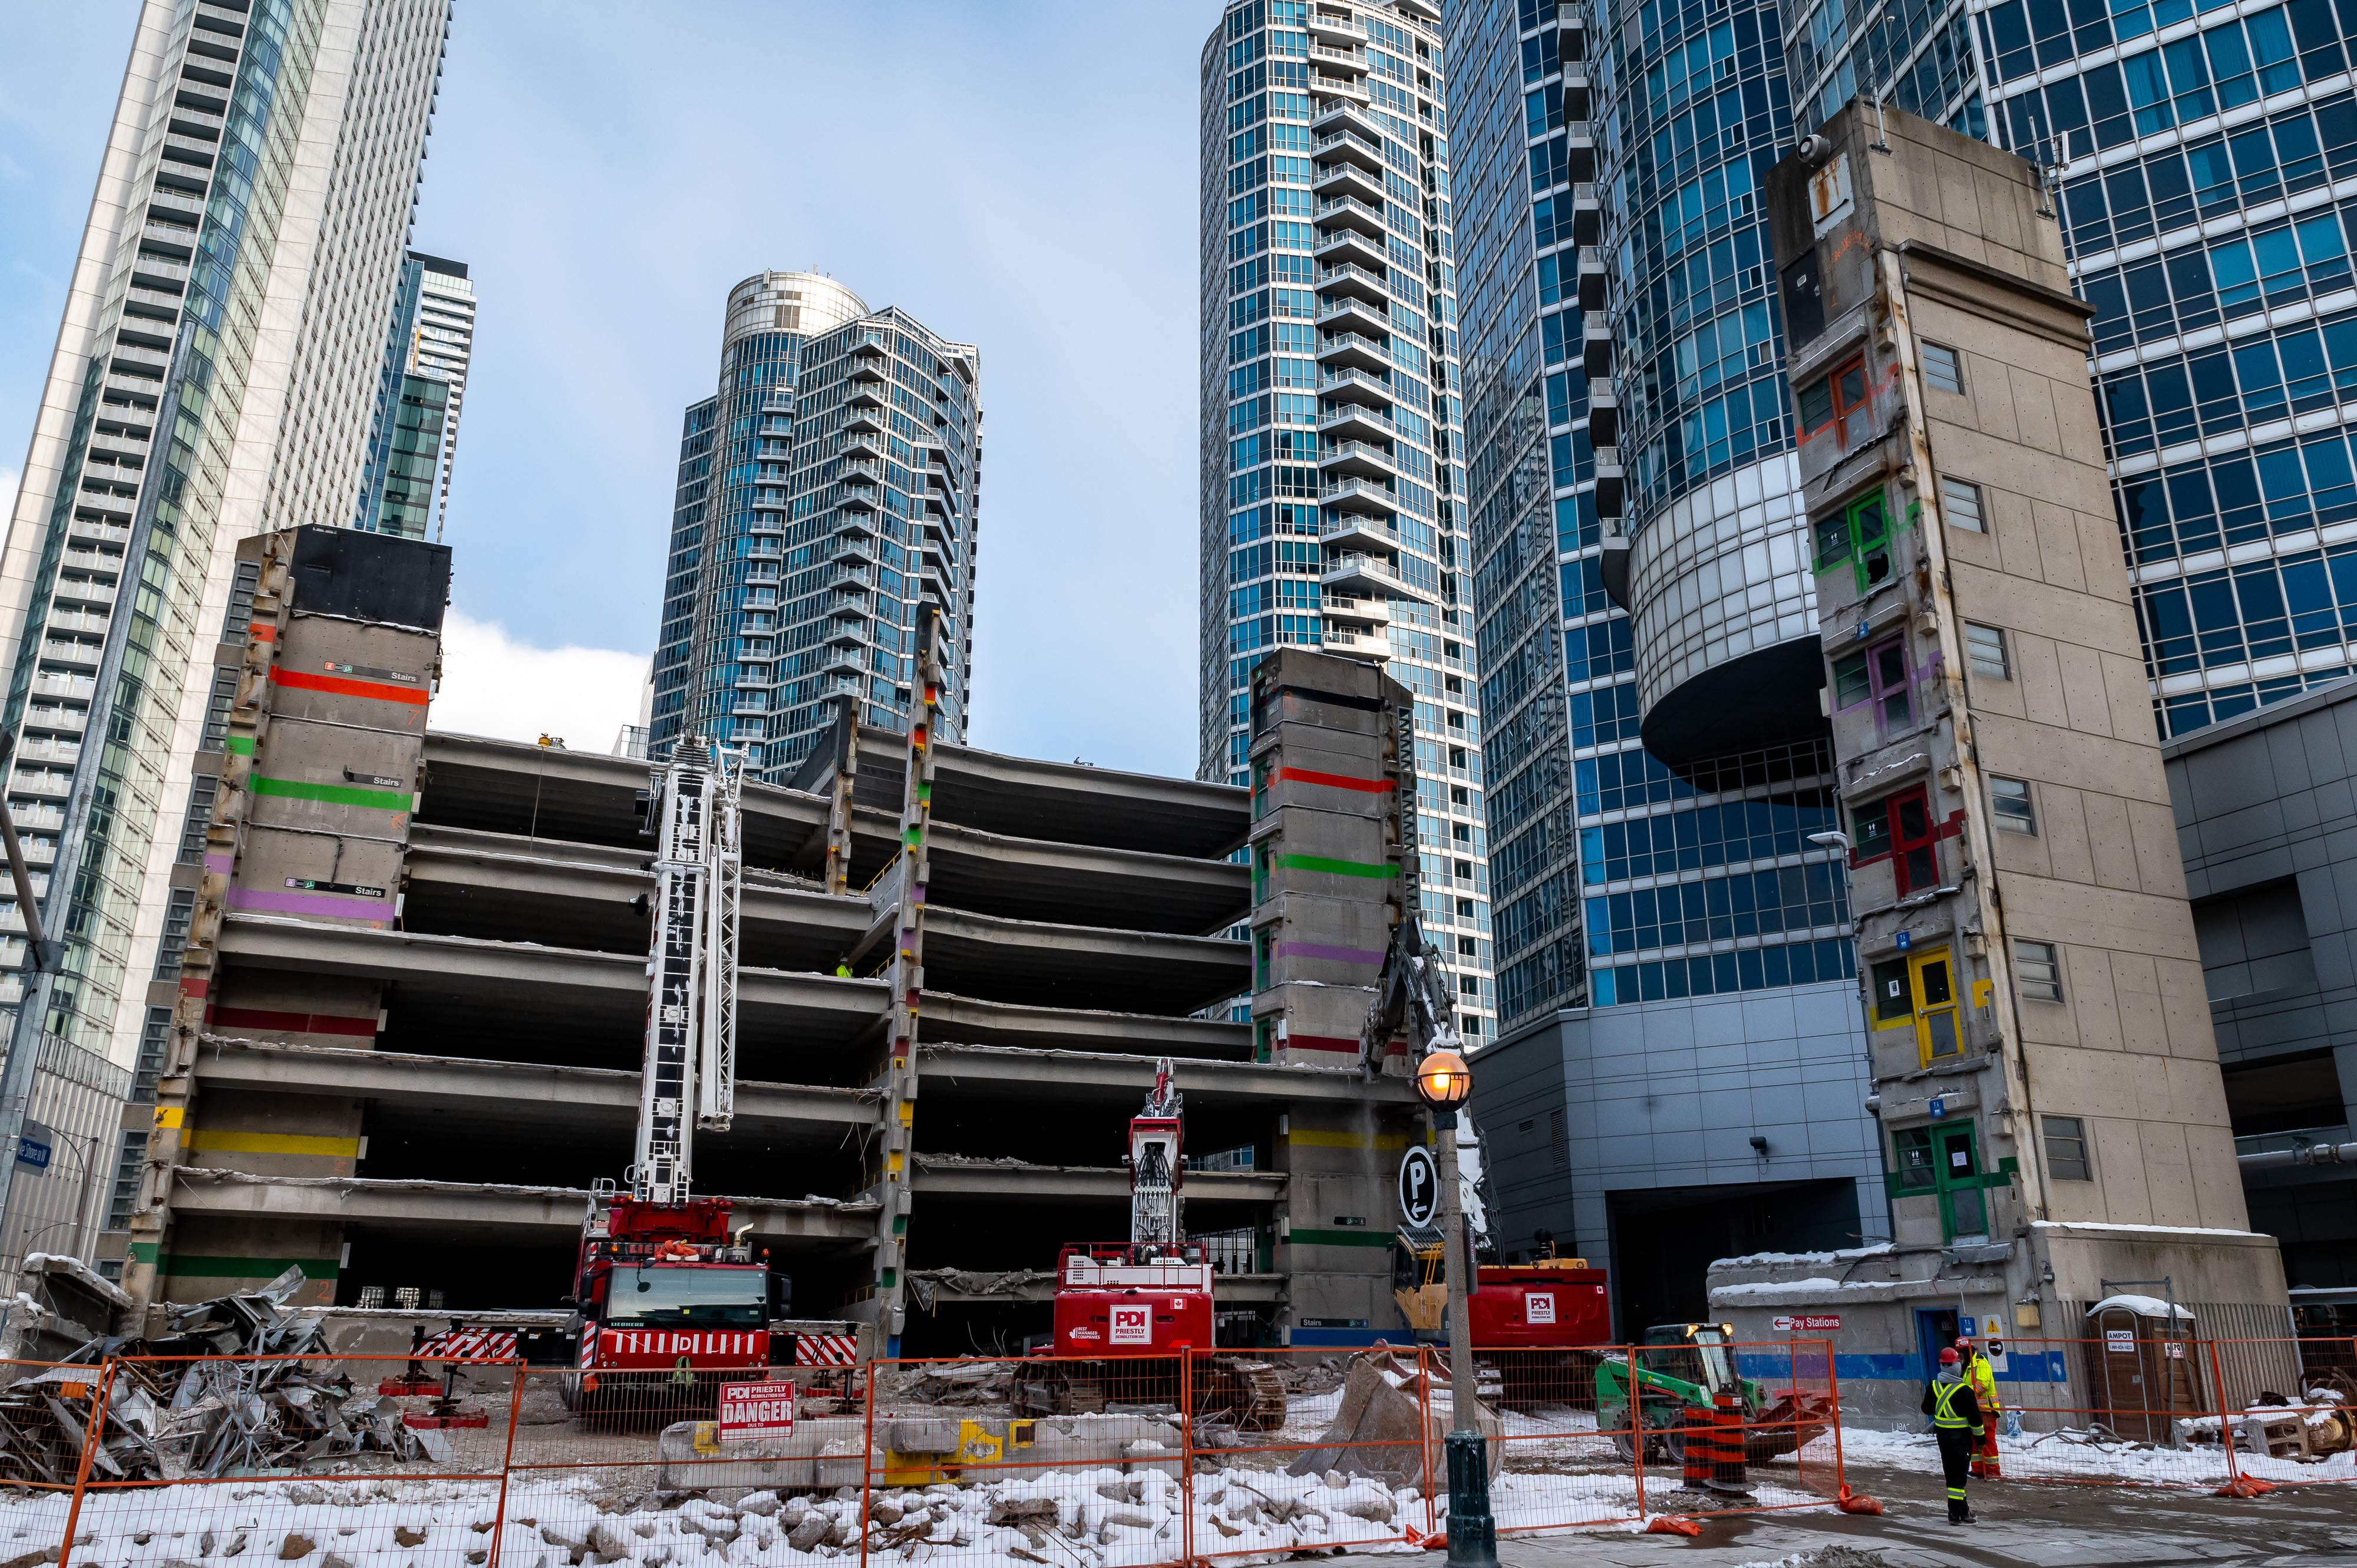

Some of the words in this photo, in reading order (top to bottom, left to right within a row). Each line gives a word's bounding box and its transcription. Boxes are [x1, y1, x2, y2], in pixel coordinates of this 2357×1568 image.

[391, 672, 416, 682] Stairs
[408, 709, 421, 725] 7
[374, 777, 400, 786] Stairs
[355, 887, 382, 896] Stairs
[1409, 1161, 1426, 1200] P
[317, 1281, 331, 1300] 2
[1531, 1298, 1550, 1309] PDI
[1115, 1311, 1145, 1326] PDI
[1790, 1318, 1804, 1330] Pay
[1807, 1317, 1840, 1327] Stations
[727, 1387, 750, 1399] PDI
[722, 1401, 792, 1424] DANGER
